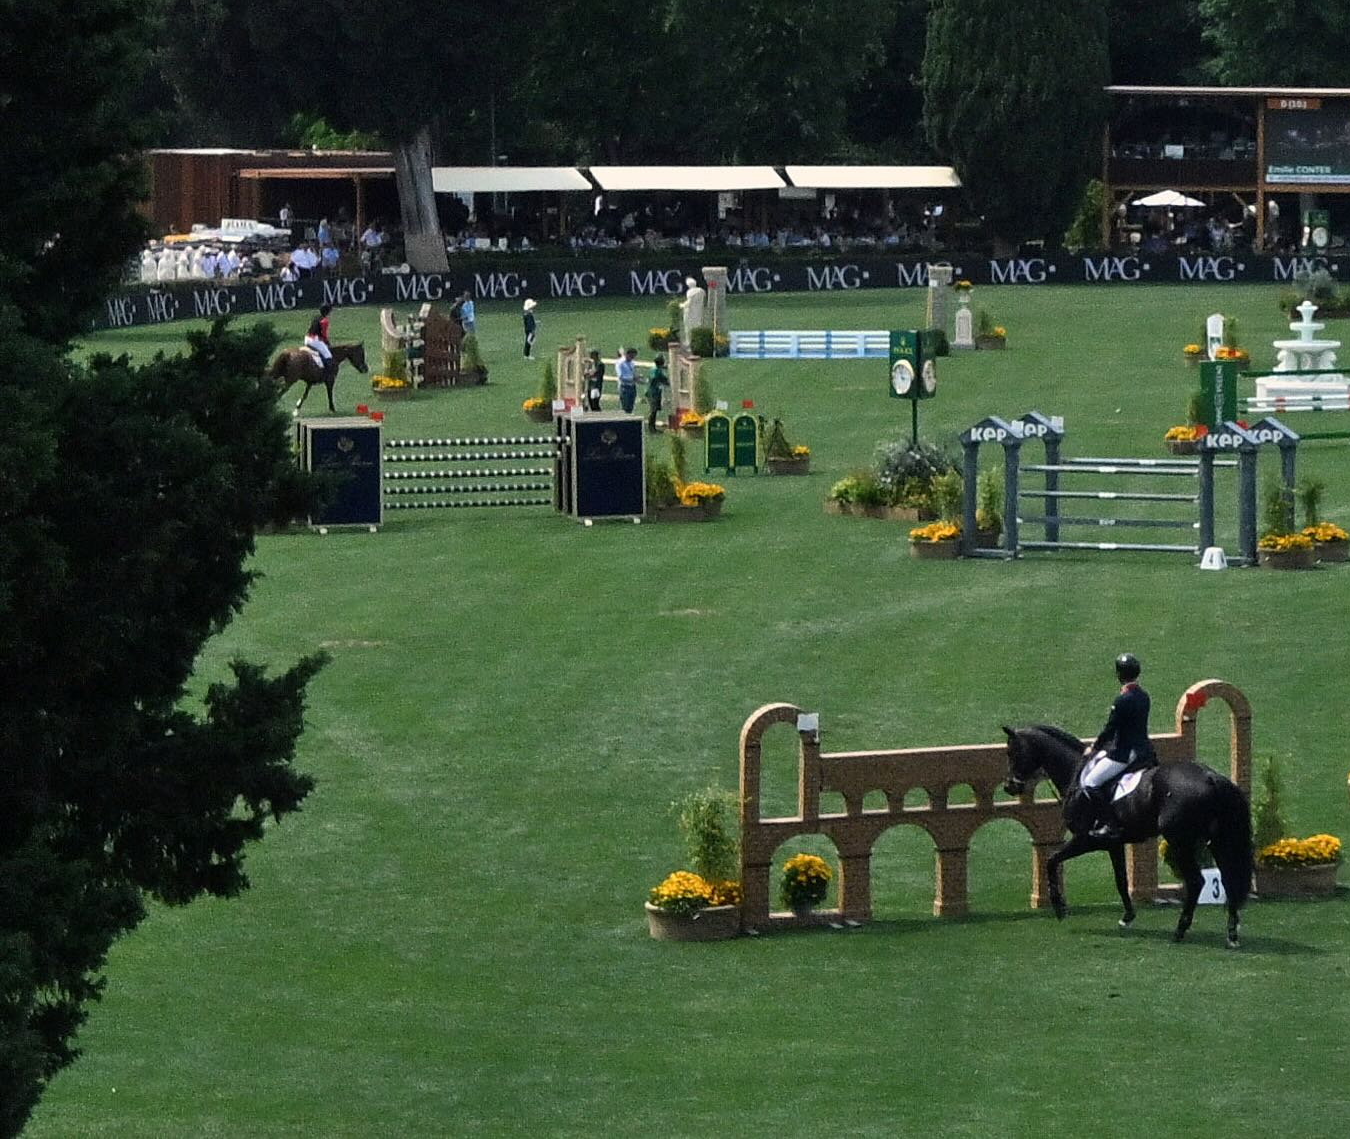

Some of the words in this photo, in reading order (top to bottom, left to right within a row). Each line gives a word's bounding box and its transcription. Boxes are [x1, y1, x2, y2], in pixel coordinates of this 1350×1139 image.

[807, 265, 860, 290] MAG
[990, 258, 1046, 283] MAG
[1084, 256, 1141, 281] MAG
[1179, 256, 1235, 281] MAG
[323, 277, 367, 304] MAG
[396, 273, 442, 301] MAG
[475, 272, 520, 298] MAG
[550, 271, 597, 297] MAG
[630, 269, 683, 295] MAG
[1212, 876, 1221, 899] 3
